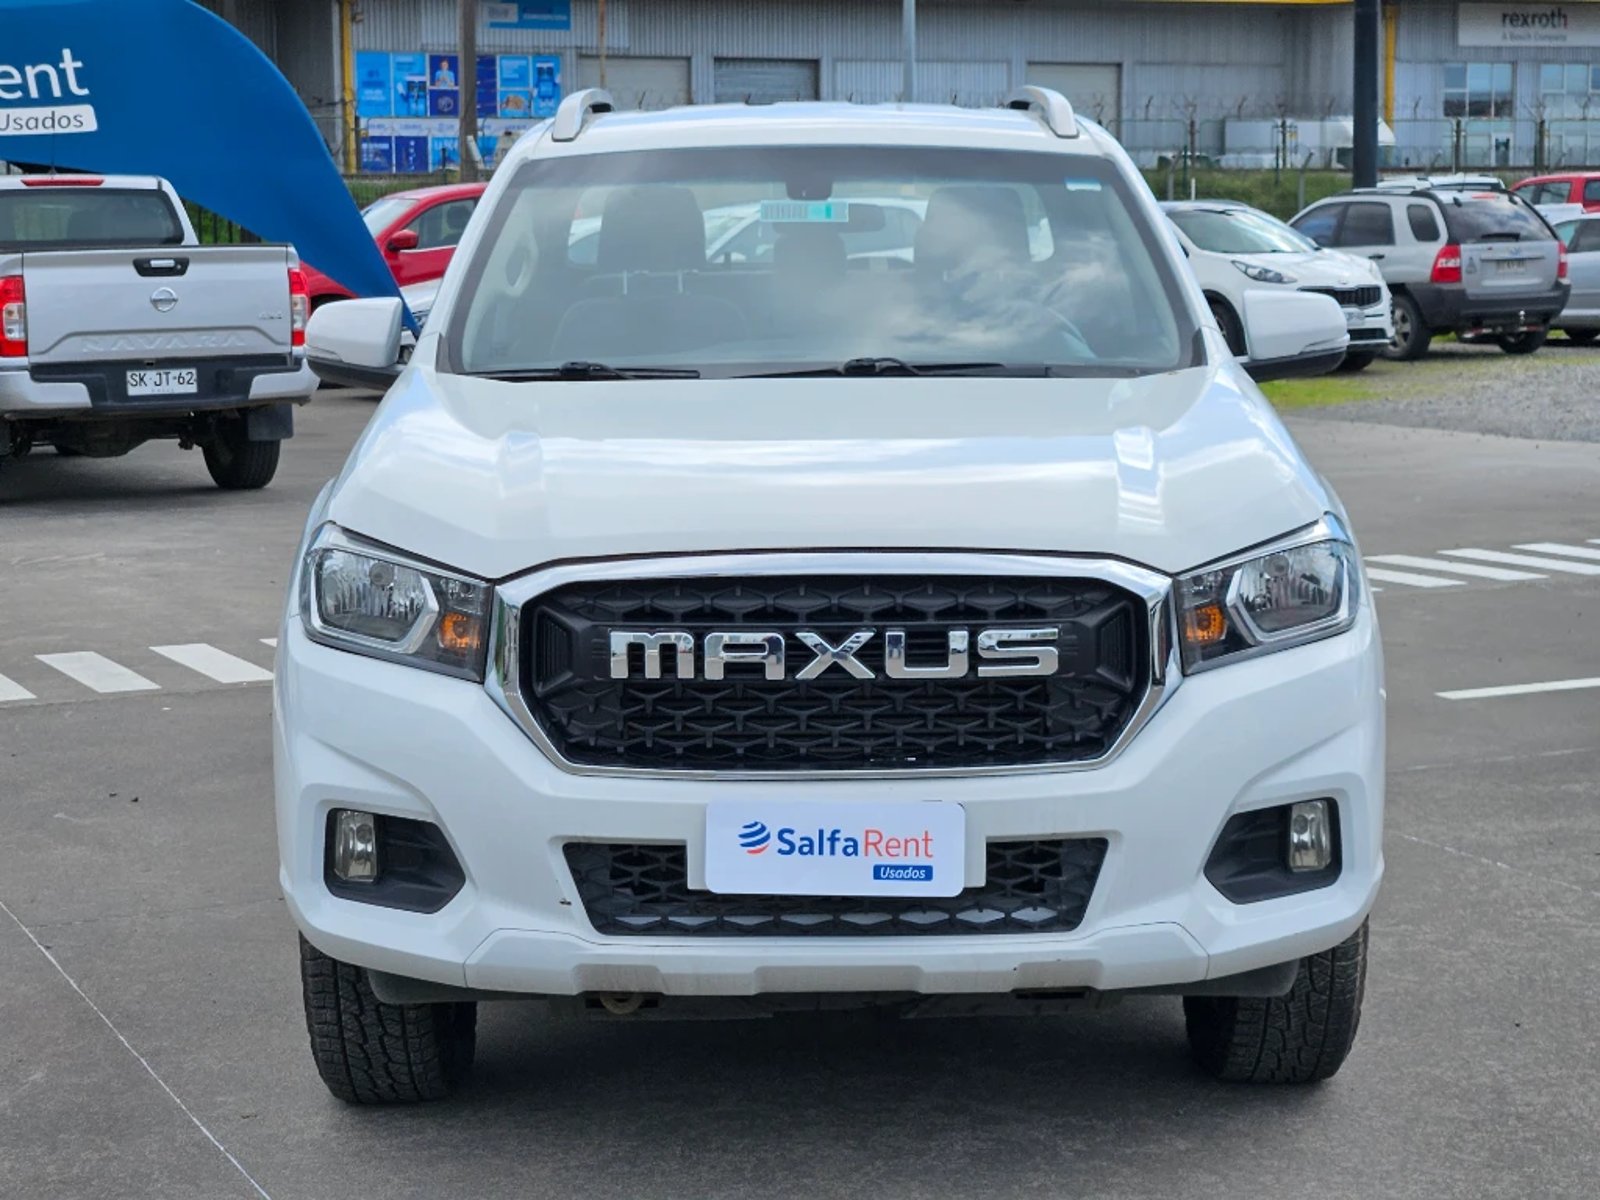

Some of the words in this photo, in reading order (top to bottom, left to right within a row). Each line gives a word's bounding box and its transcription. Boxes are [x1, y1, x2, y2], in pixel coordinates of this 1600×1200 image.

[1502, 7, 1568, 29] rexroth
[82, 331, 247, 352] NAVARA
[609, 627, 1060, 681] MAXUS
[777, 828, 934, 858] SalfaRent
[880, 866, 926, 880] Usados
